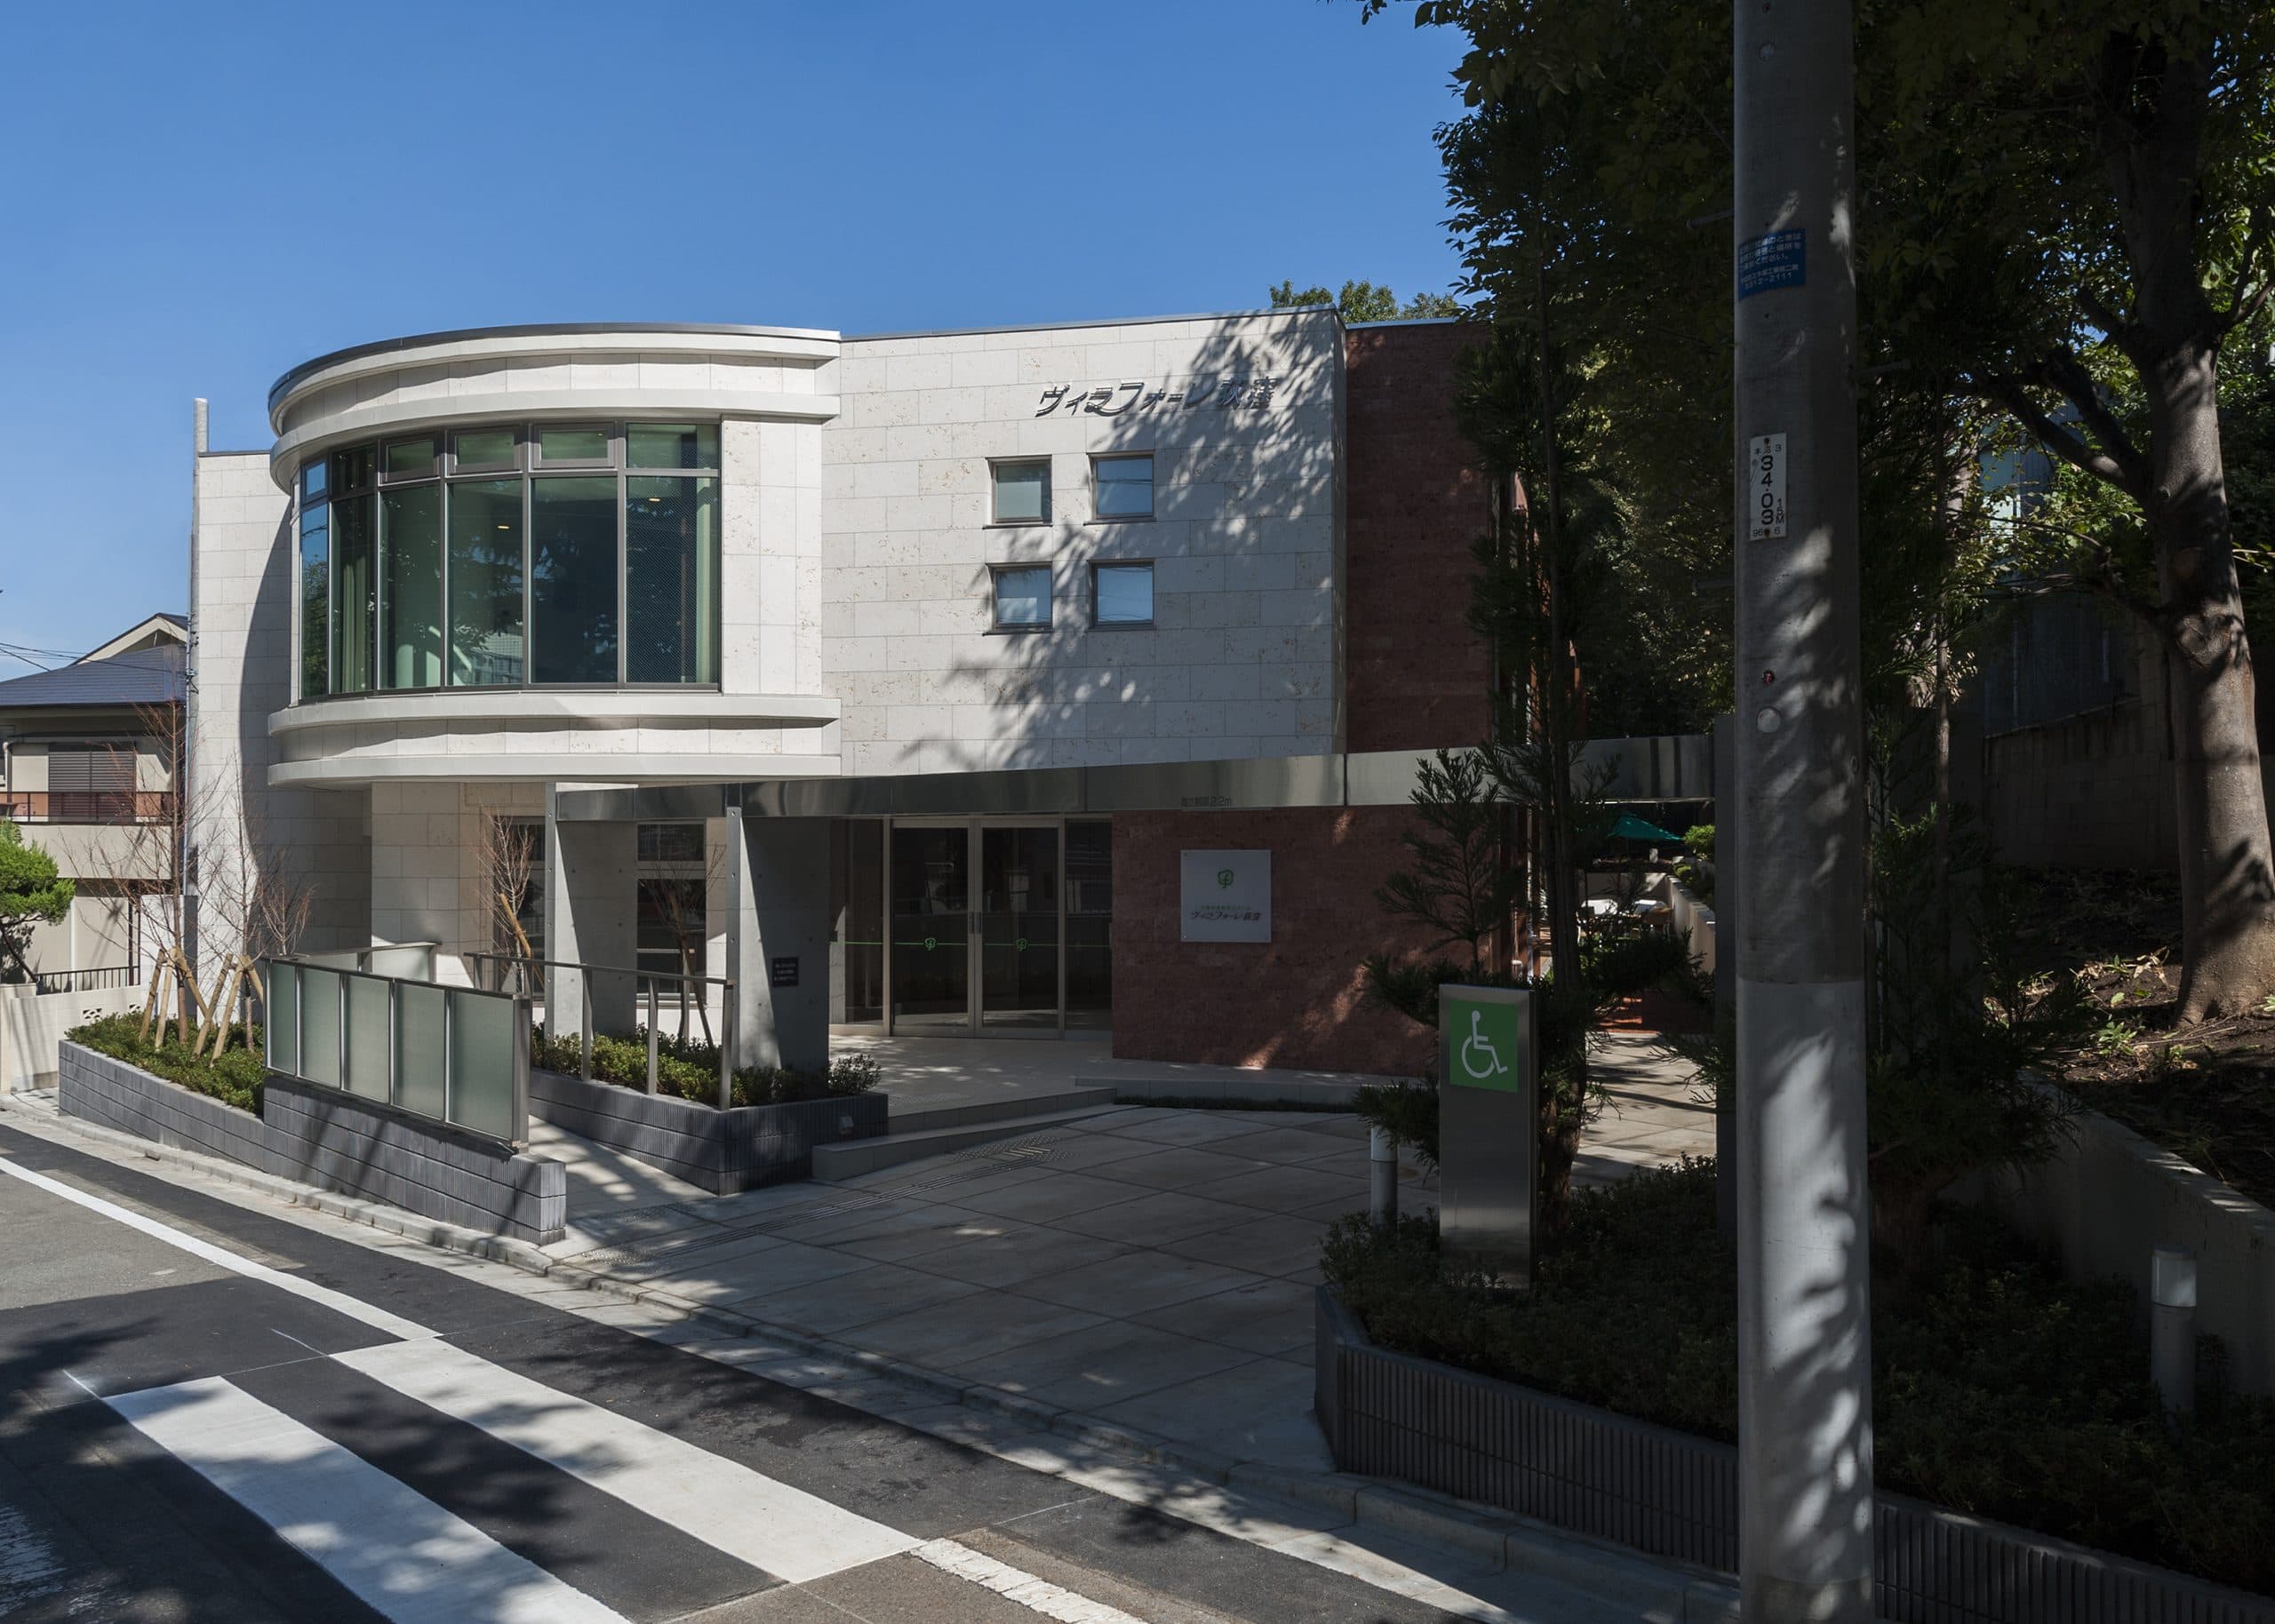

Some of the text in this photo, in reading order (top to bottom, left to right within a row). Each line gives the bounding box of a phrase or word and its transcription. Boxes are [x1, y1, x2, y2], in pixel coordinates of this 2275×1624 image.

[1035, 376, 1280, 418] ヴィラフォーレ荻窪
